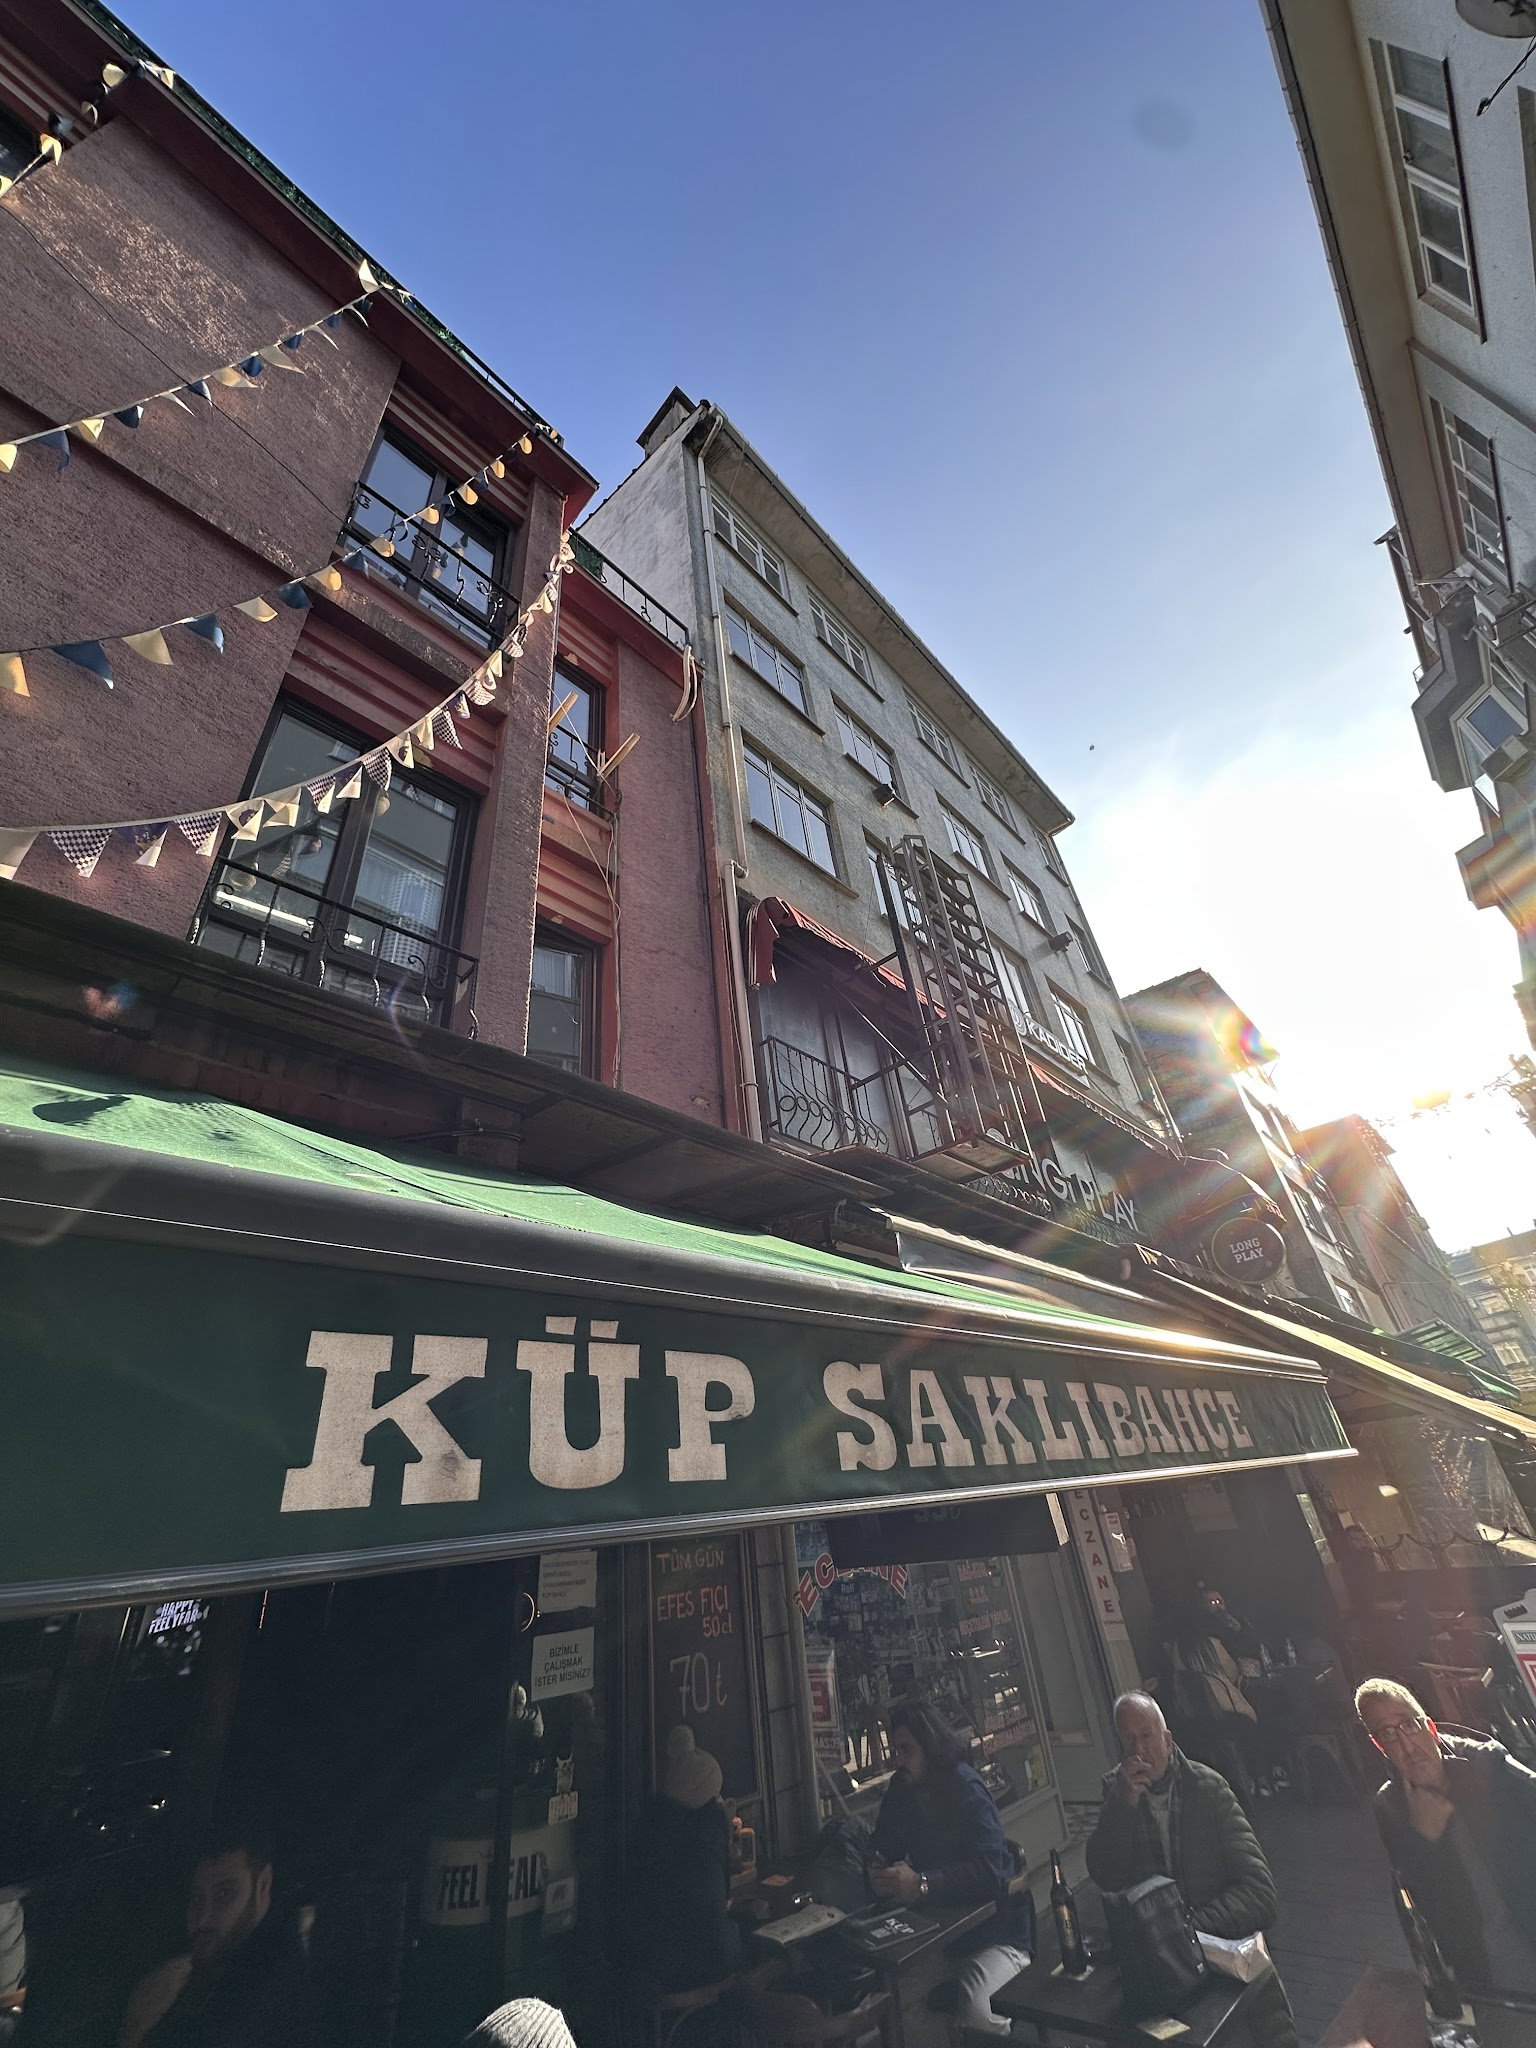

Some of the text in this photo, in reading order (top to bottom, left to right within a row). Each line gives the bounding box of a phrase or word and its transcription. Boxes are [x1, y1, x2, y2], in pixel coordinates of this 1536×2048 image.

[1076, 1162, 1139, 1232] PLAY
[1230, 1237, 1260, 1254] LONG
[1234, 1247, 1264, 1264] PLAY
[280, 1315, 1251, 1513] KÜP SAKLIBAHÇE
[656, 1545, 725, 1575] TÜM GÜN
[1073, 1488, 1115, 1614] ECZANE
[160, 1599, 195, 1618] HAPPY
[656, 1590, 696, 1622] EFES
[669, 1651, 710, 1717] 70
[437, 1864, 481, 1911] FEEL
